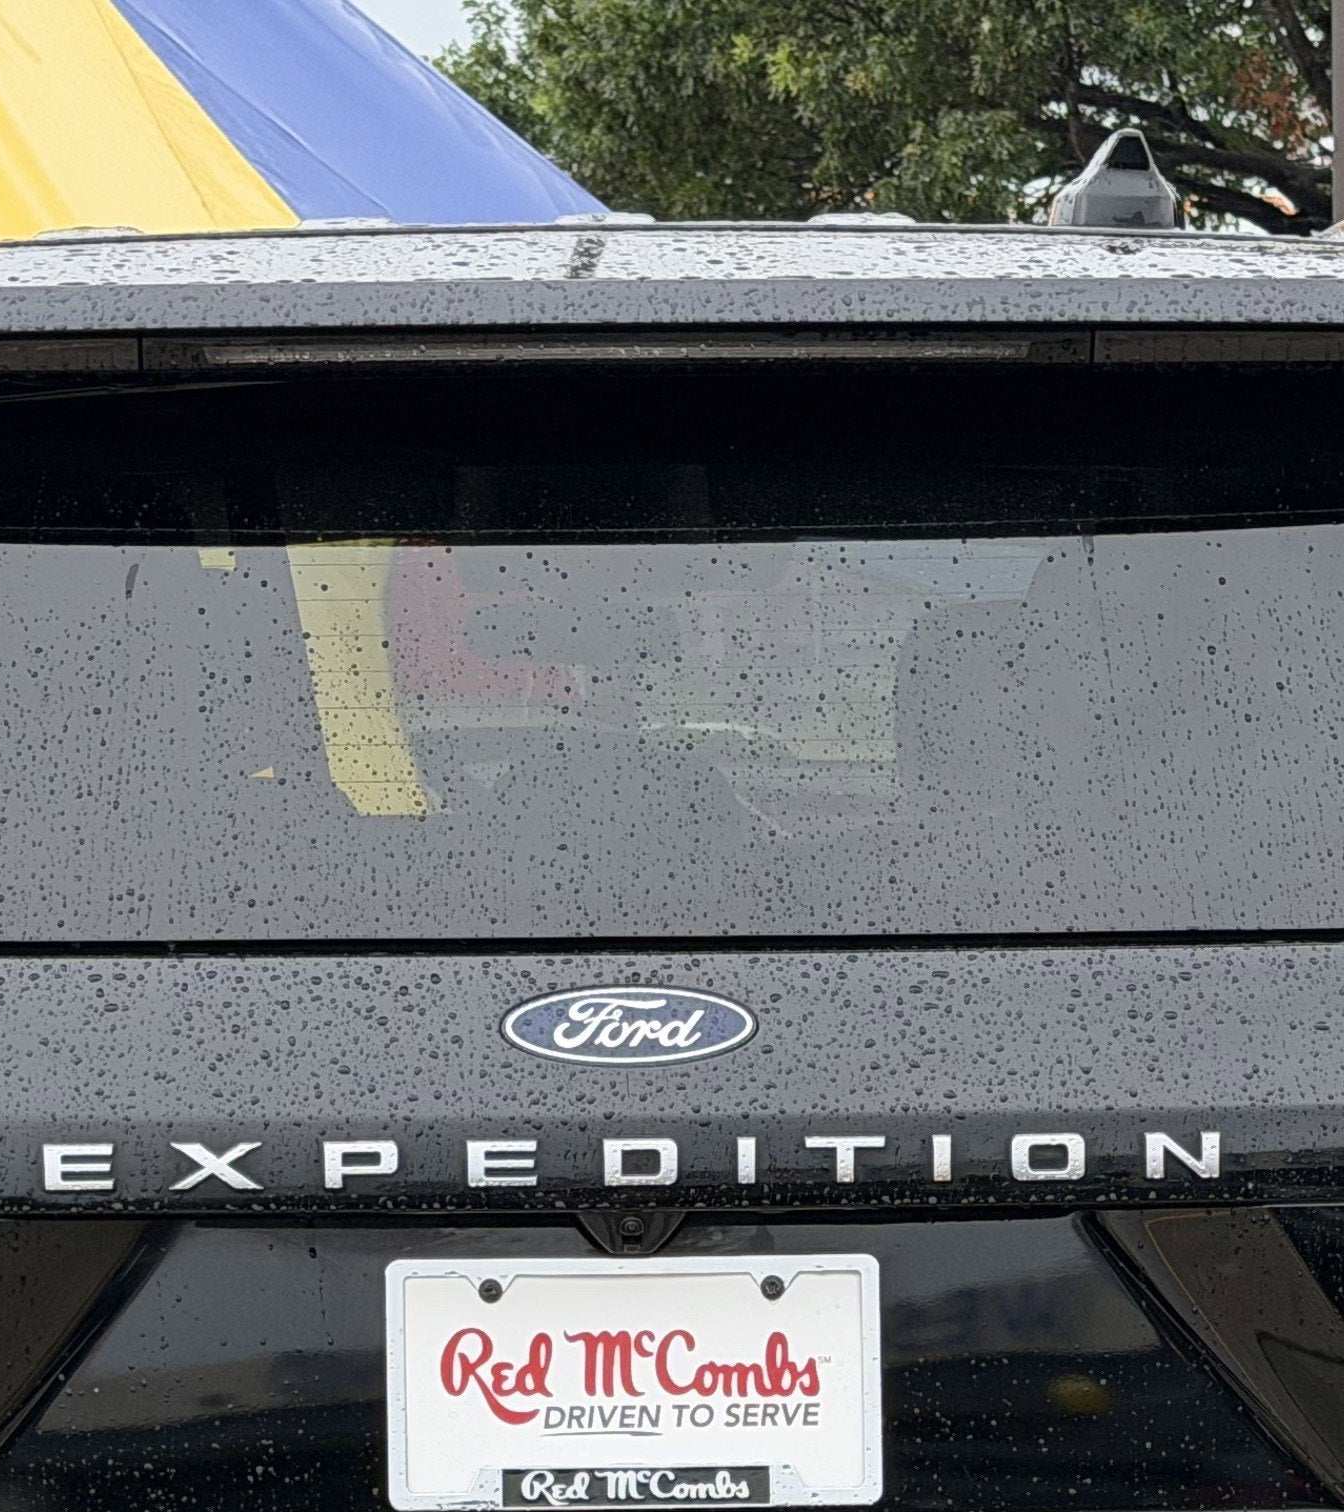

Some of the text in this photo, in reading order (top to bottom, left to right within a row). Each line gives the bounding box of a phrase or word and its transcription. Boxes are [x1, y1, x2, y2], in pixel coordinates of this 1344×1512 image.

[553, 998, 705, 1048] Ford
[43, 1131, 1221, 1191] EXPEDITION
[440, 1327, 553, 1425] Red
[564, 1328, 820, 1398] McCombs
[543, 1402, 821, 1429] DRIVEN TO SERVE
[521, 1468, 751, 1505] Red McCombs
